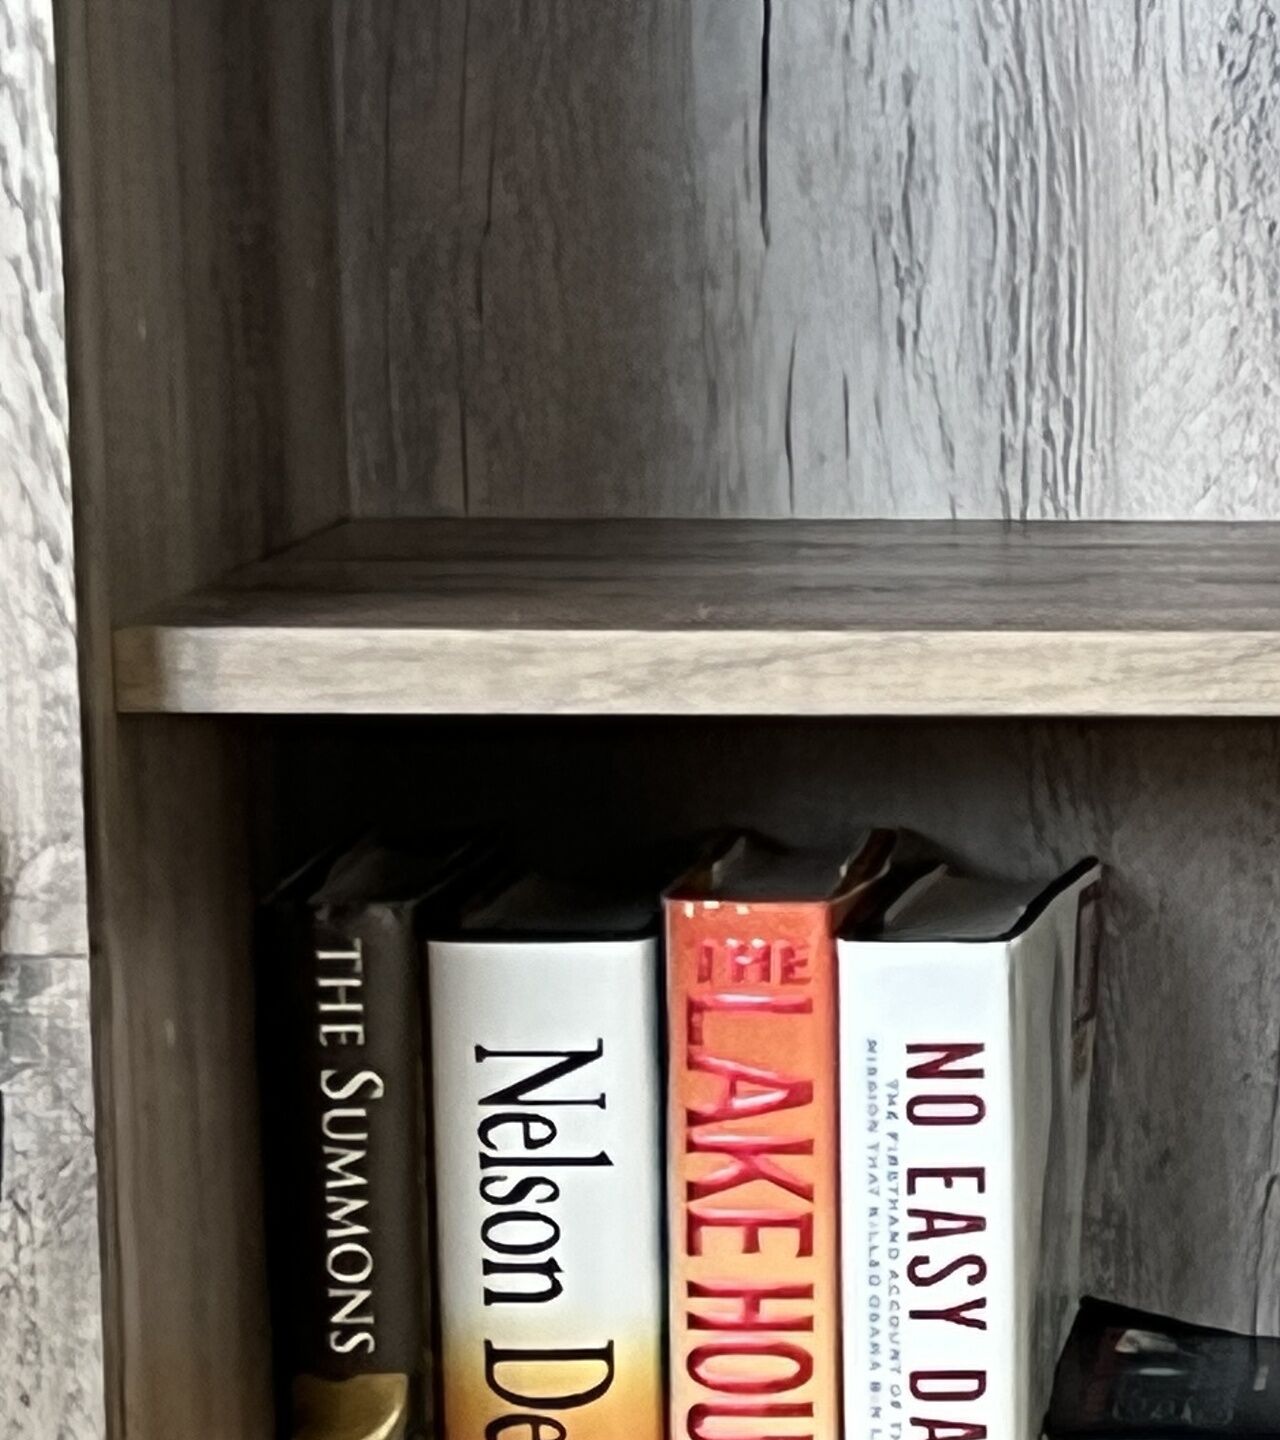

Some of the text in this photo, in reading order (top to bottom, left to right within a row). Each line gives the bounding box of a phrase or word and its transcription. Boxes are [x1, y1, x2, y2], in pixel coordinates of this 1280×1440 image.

[696, 936, 814, 986] THE
[314, 937, 386, 1355] THE SUMMONS
[474, 1036, 615, 1307] Nelson
[685, 990, 815, 1259] LAKE
[905, 1042, 987, 1126] NO
[905, 1165, 988, 1331] EASY
